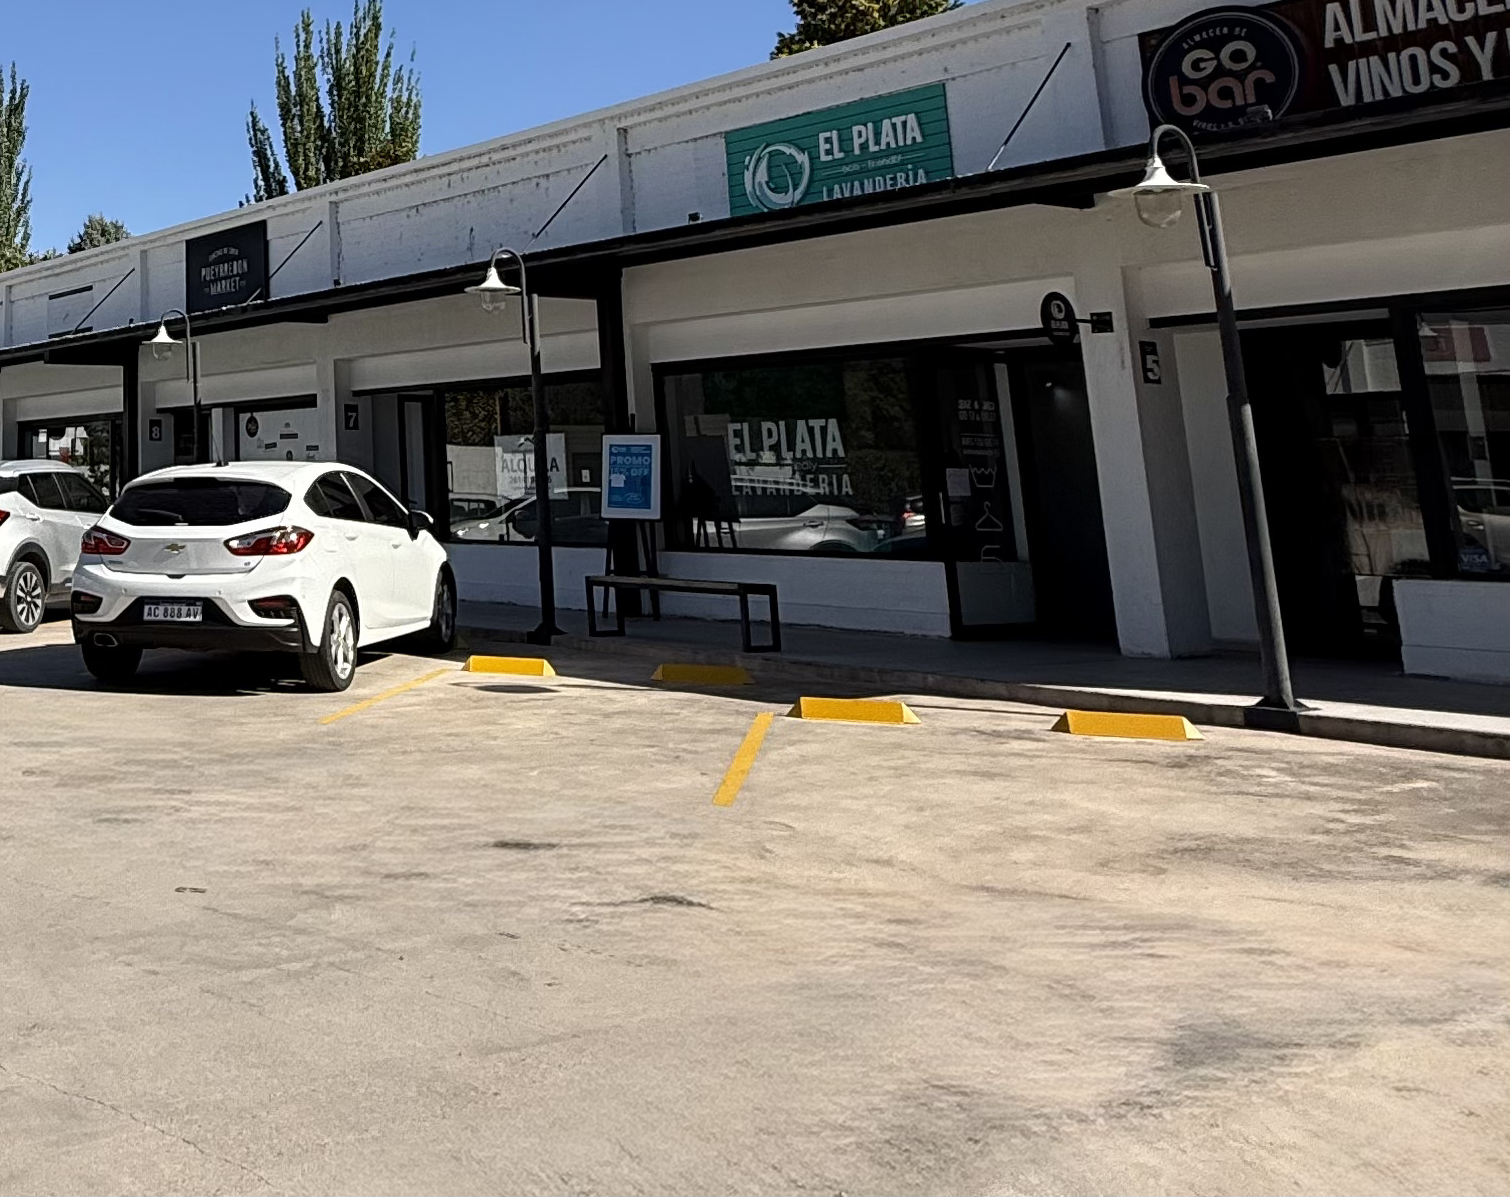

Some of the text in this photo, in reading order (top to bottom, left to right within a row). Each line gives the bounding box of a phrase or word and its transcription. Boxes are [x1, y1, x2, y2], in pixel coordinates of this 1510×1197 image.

[1181, 40, 1257, 79] GO
[1327, 40, 1461, 107] VINOS
[1464, 30, 1498, 81] Y
[1168, 69, 1276, 116] bar
[818, 113, 923, 162] EL PLATA
[210, 276, 240, 295] MARKET
[1146, 354, 1161, 381] 5
[347, 412, 357, 427] 7
[151, 425, 160, 439] 8
[728, 418, 846, 461] EL PLATA
[501, 457, 560, 474] ALQUA
[610, 455, 651, 465] PROMO
[731, 473, 853, 496] LAVANDERIA
[1460, 554, 1488, 563] VISA
[147, 606, 160, 618] AC
[163, 607, 183, 619] 888
